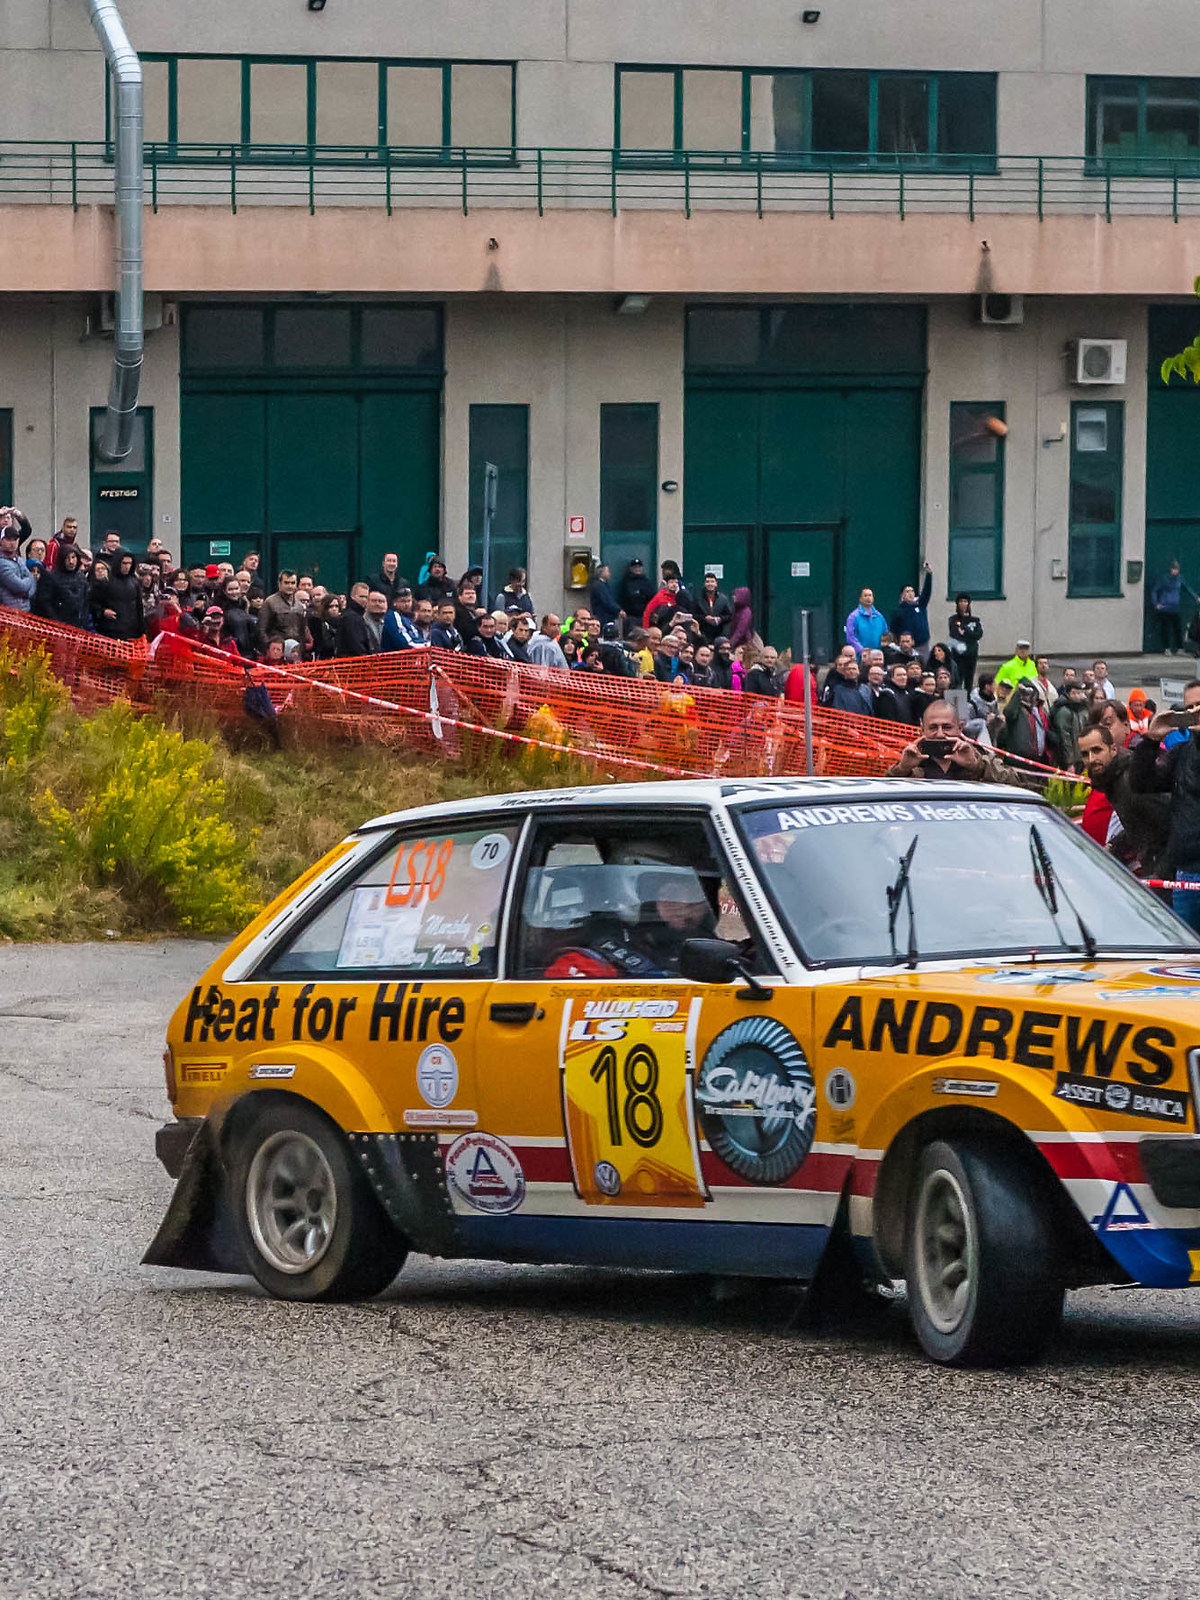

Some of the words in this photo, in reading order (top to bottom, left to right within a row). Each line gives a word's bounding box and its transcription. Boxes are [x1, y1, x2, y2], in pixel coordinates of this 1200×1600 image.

[777, 804, 914, 831] ANDREWS
[914, 804, 972, 821] Heat
[973, 804, 1004, 820] for
[385, 838, 454, 906] LS18
[478, 842, 499, 861] 70
[184, 985, 279, 1043] Heat
[292, 984, 358, 1041] for
[369, 983, 465, 1042] Hire
[569, 1020, 628, 1040] LS
[823, 996, 1175, 1086] ANDREWS
[590, 1043, 663, 1148] 18
[1058, 1083, 1104, 1104] ASSET
[1133, 1094, 1184, 1117] BANCA
